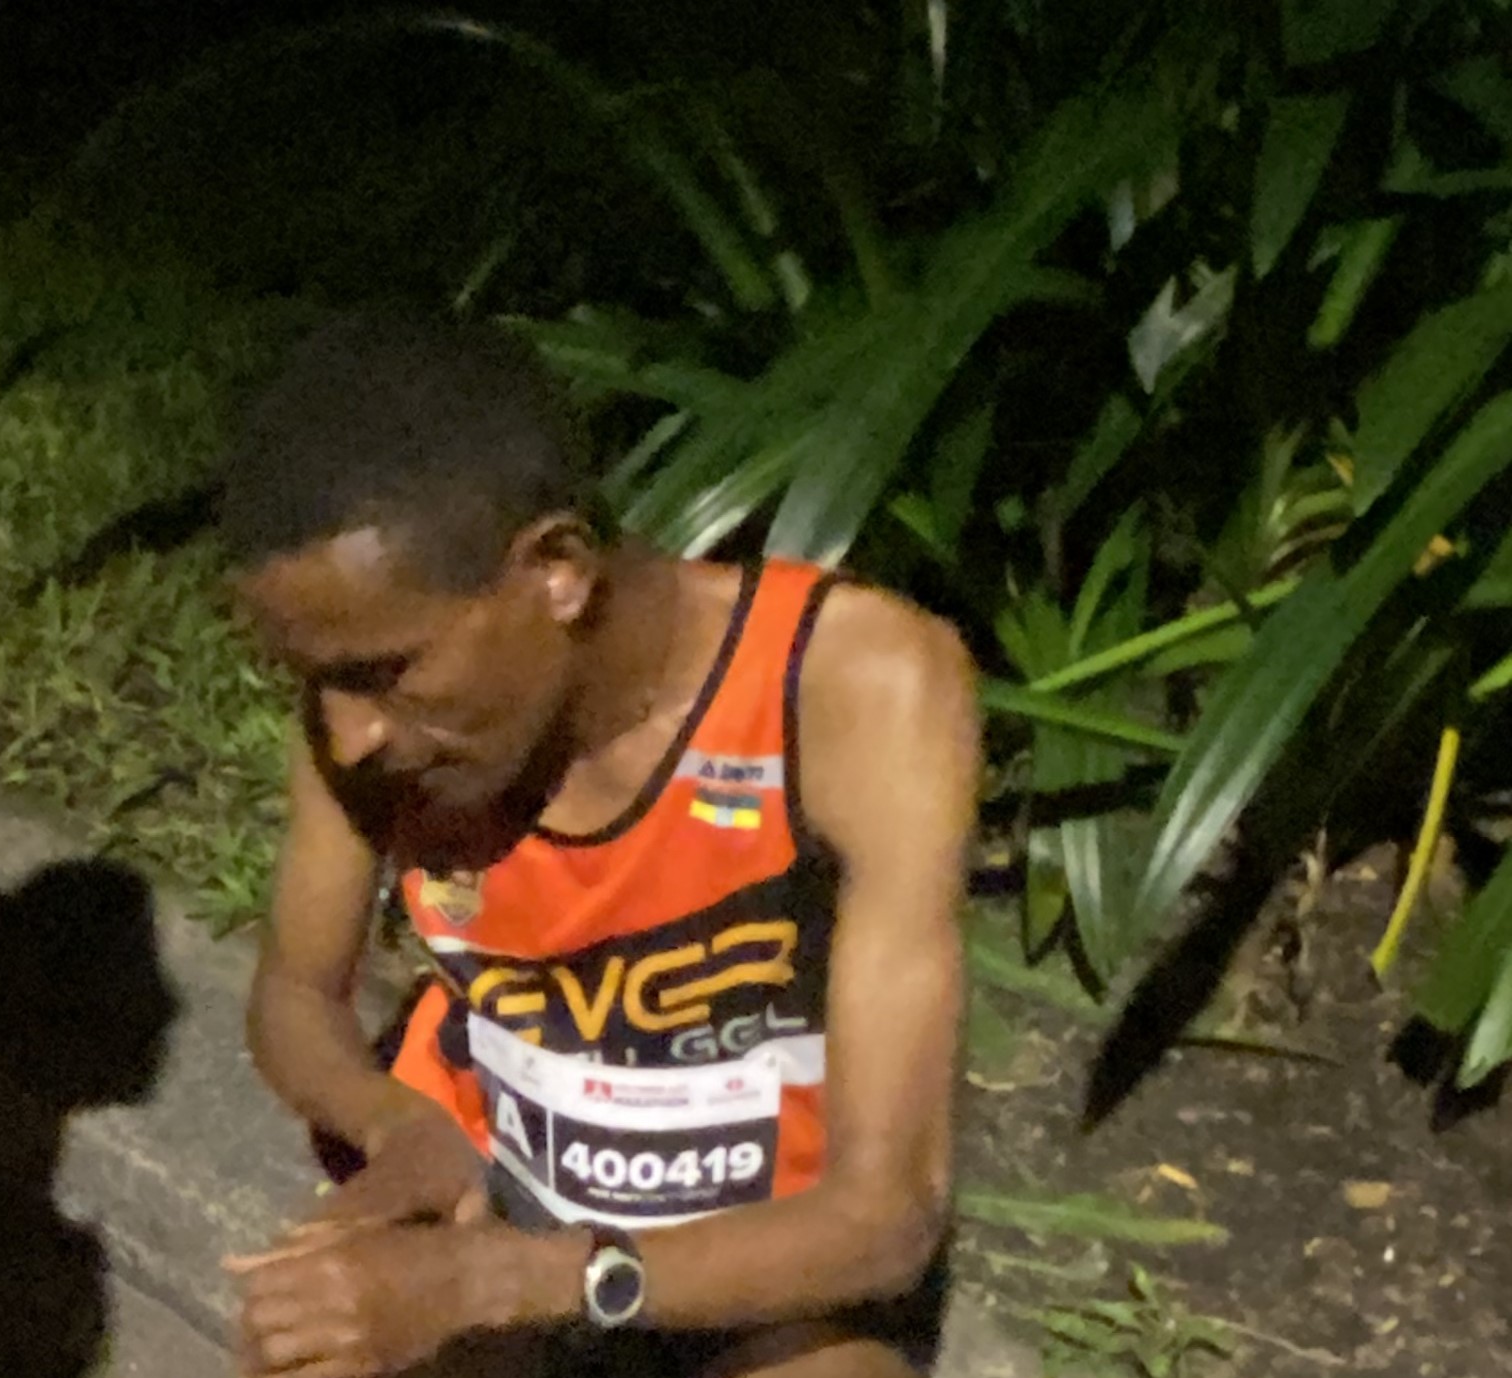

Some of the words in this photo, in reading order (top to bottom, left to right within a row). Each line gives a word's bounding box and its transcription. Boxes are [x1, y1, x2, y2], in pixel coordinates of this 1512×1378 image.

[469, 920, 798, 1047] EVER
[496, 1091, 533, 1160] A
[560, 1141, 764, 1189] 400419
